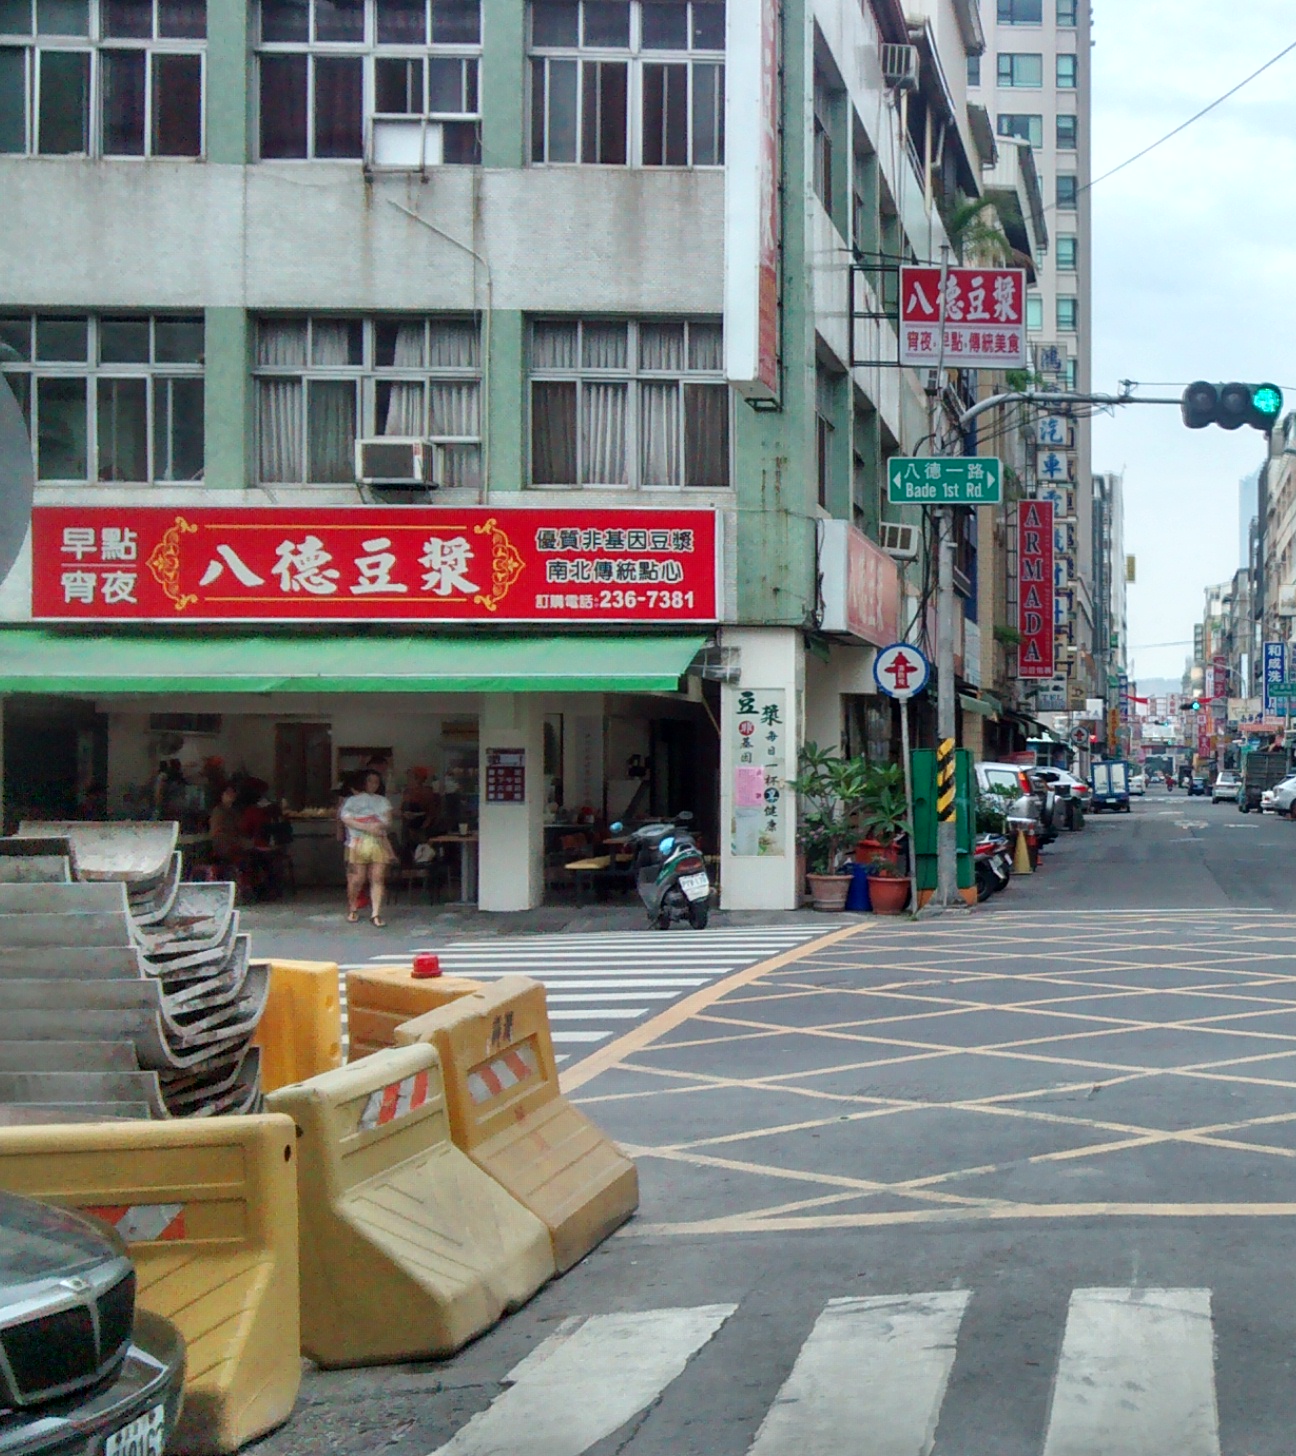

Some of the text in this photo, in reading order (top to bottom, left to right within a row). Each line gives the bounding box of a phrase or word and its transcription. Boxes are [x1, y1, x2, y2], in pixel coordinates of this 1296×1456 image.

[906, 274, 1018, 322] 八德豆漿
[904, 462, 984, 480] 八德一路
[906, 483, 936, 498] Bade
[942, 483, 959, 498] 1st
[61, 528, 138, 561] 早點
[536, 529, 694, 552] 優質非基因豆漿
[199, 537, 481, 598] 八德豆漿
[547, 559, 685, 583] 南北傳統點心
[1022, 504, 1042, 662] ARMADA
[61, 571, 138, 604] 宵夜
[600, 591, 694, 608] 236-7381
[737, 691, 782, 726] 豆漿
